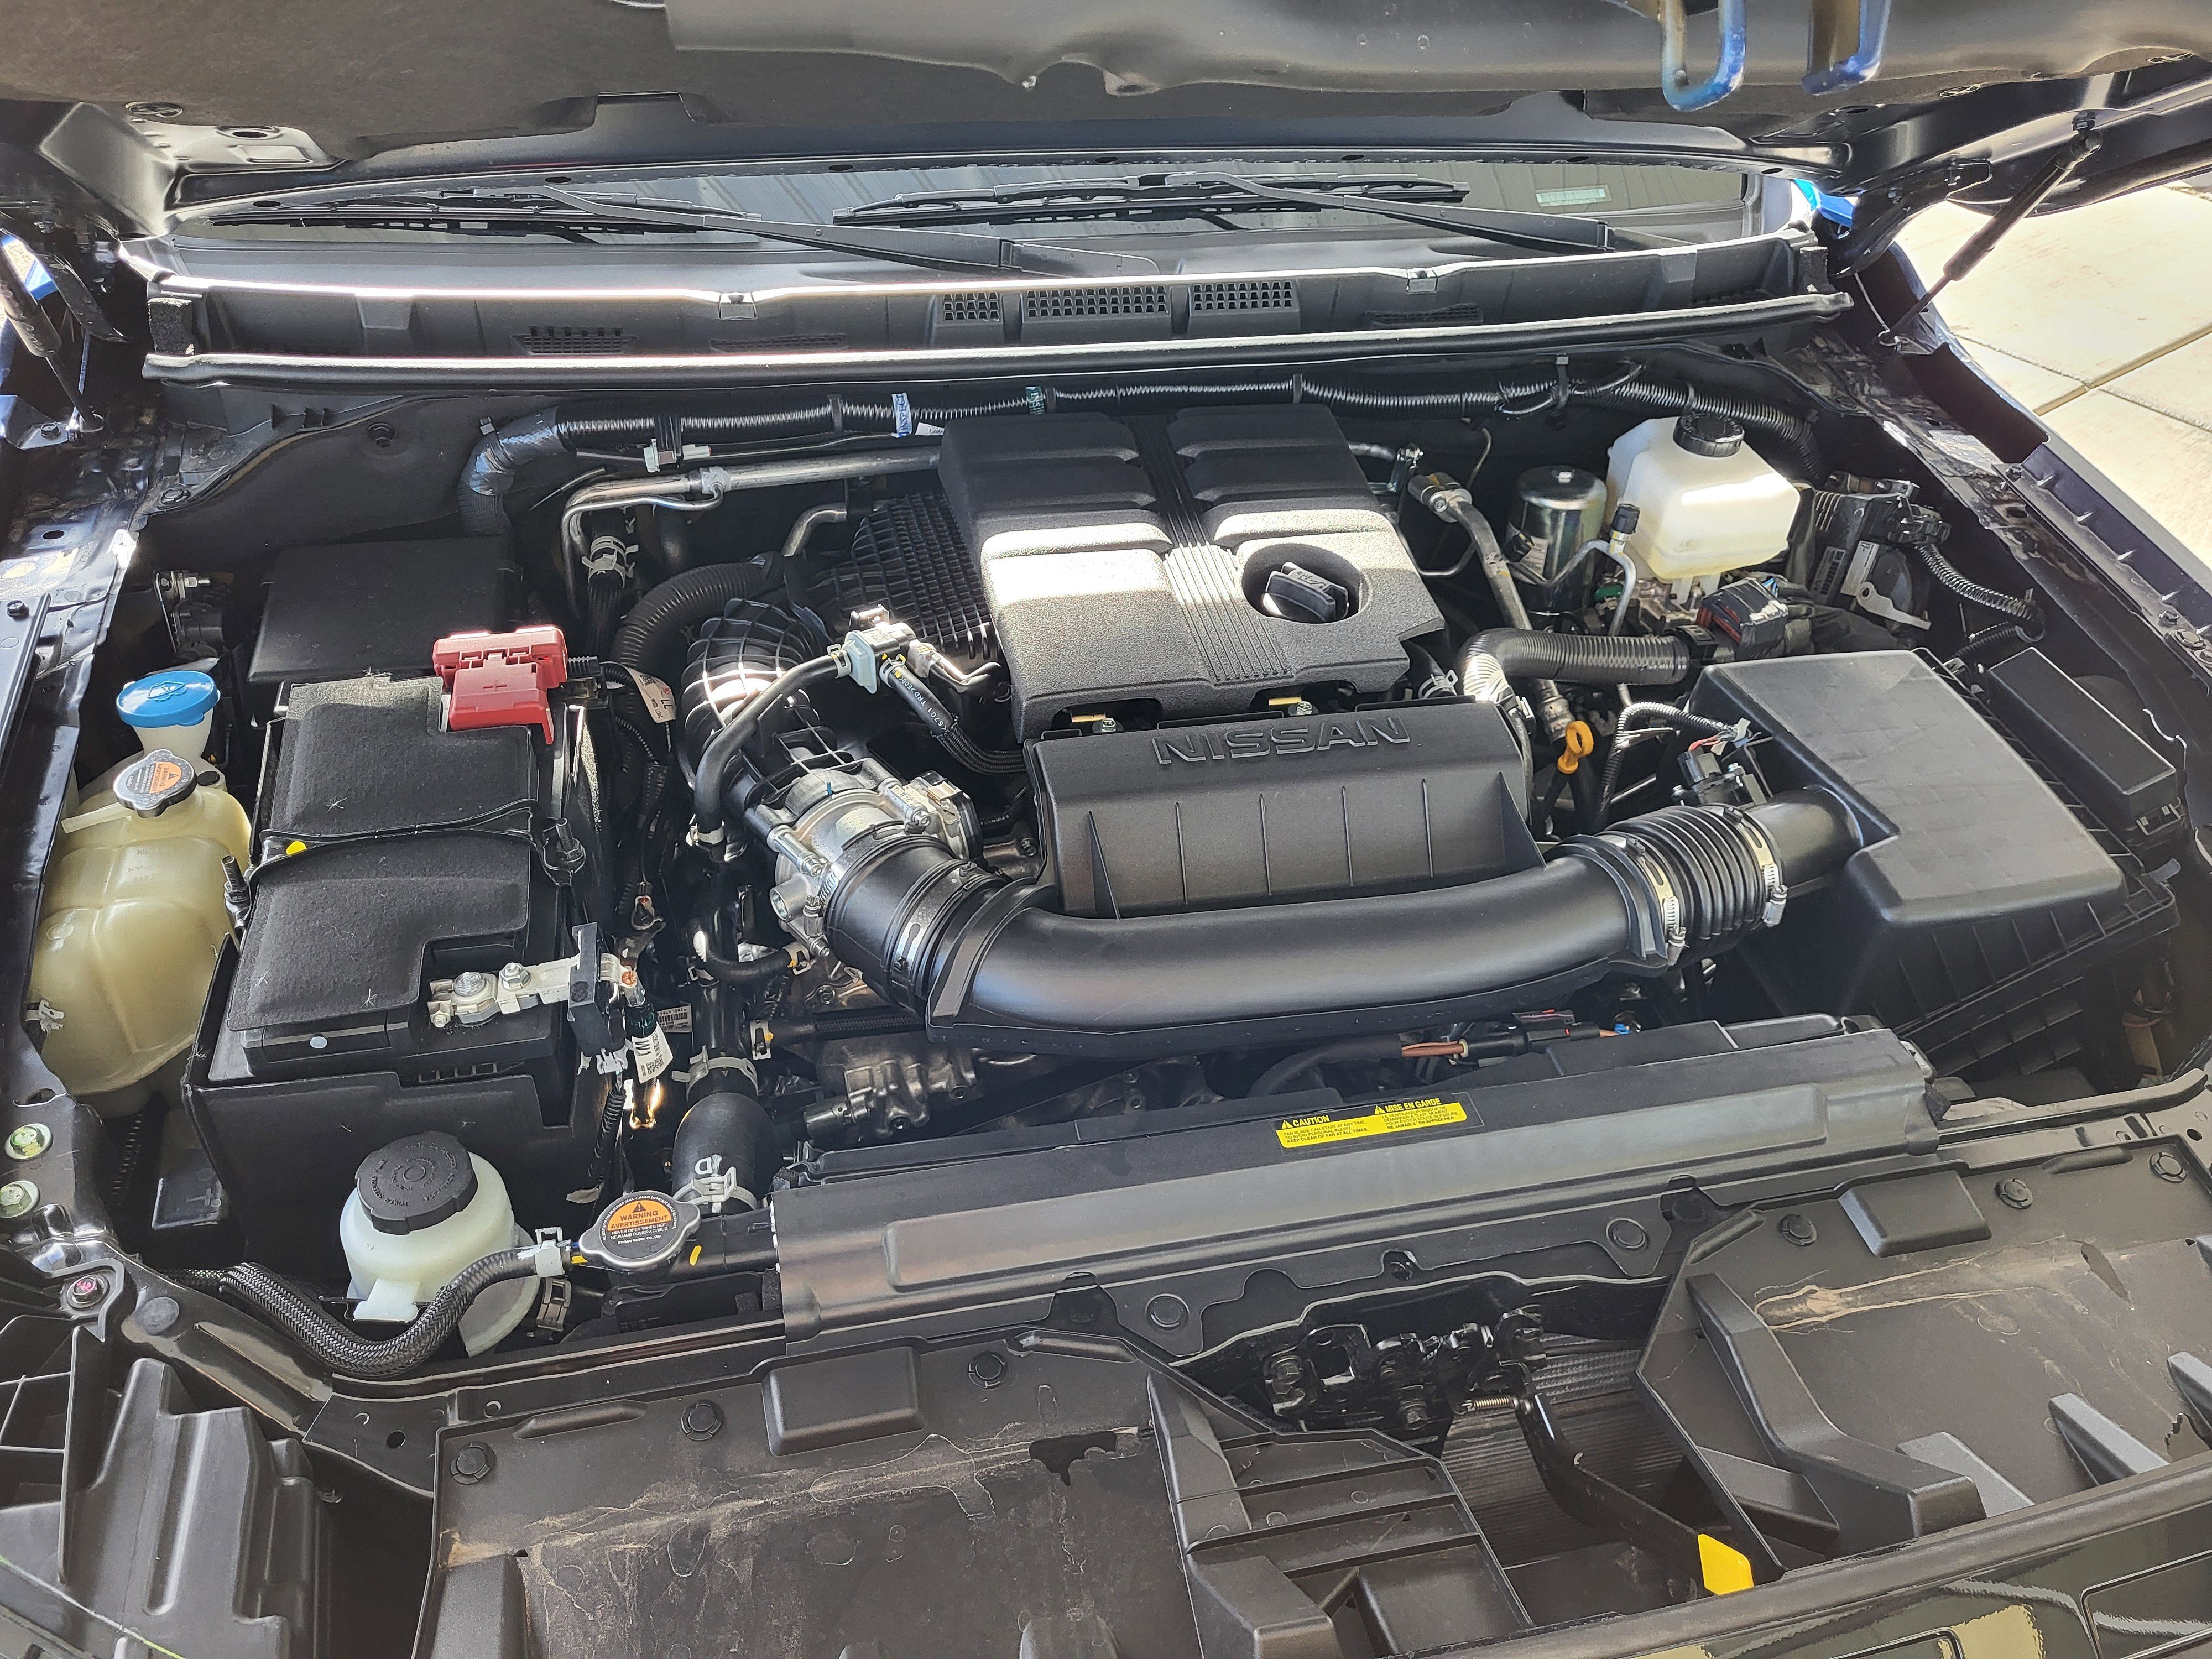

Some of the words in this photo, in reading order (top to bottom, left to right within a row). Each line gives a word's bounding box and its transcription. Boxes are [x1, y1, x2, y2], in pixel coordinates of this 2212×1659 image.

[1151, 716, 1411, 764] NISSAN
[1384, 1103, 1404, 1113] MISE
[1403, 1101, 1415, 1110] EN
[1415, 1097, 1442, 1108] GARDE
[1389, 1109, 1421, 1118] VENTILATEUR
[1292, 1114, 1331, 1127] CAUTION
[610, 1215, 669, 1229] AVERTISSEMENT
[619, 1210, 659, 1221] WARNING
